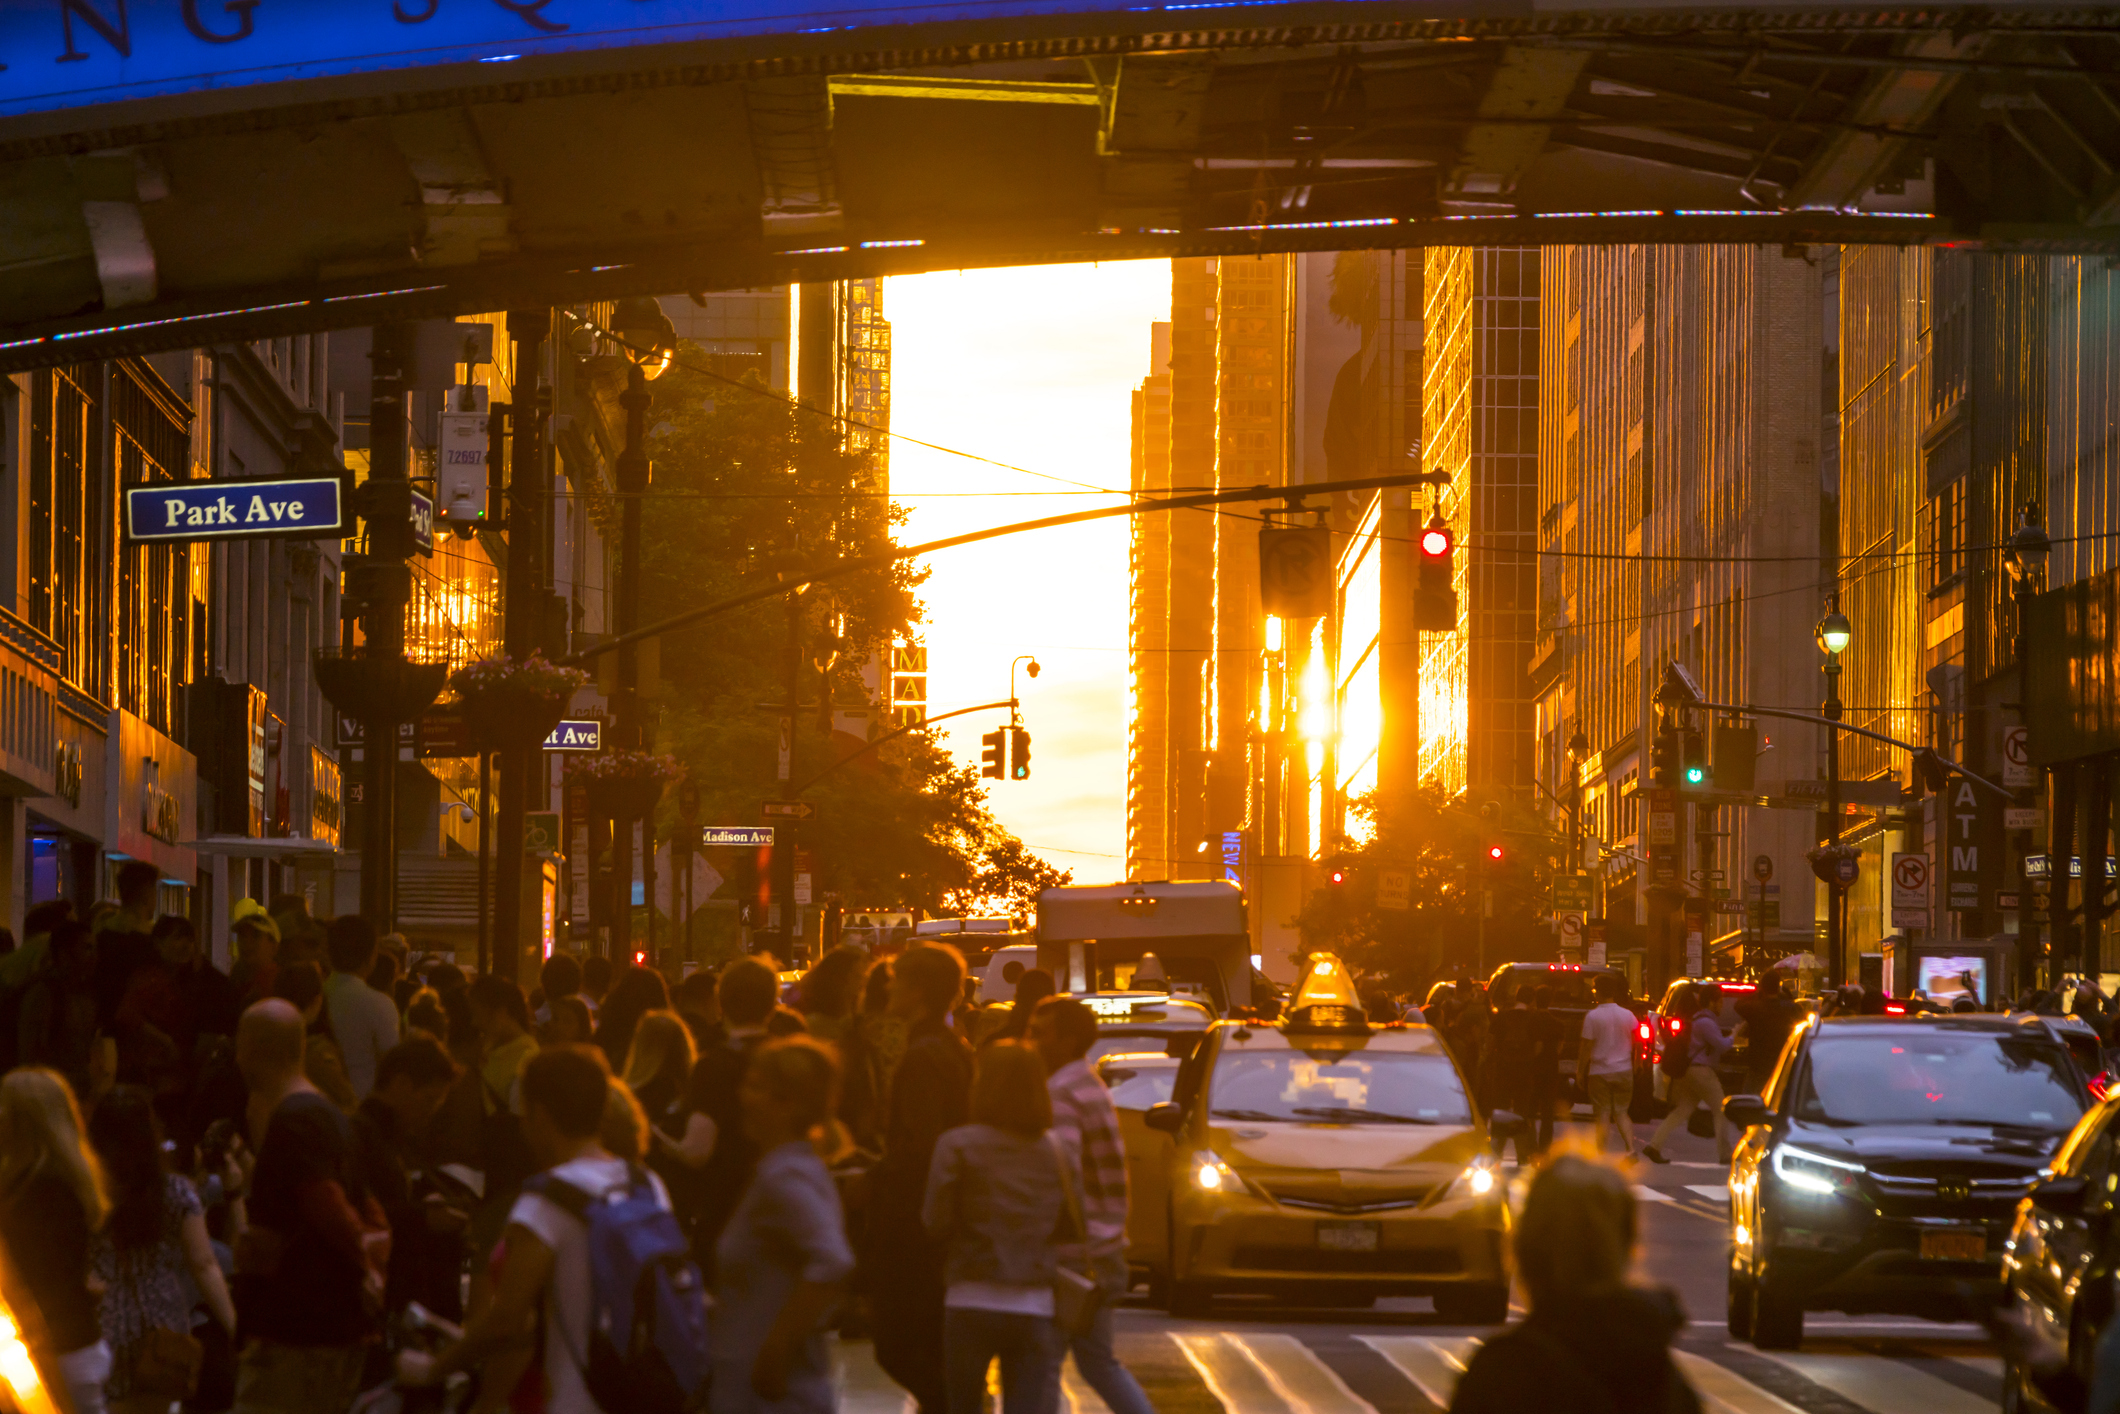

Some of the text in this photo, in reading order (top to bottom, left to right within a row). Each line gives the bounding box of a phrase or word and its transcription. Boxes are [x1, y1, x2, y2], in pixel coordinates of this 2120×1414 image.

[448, 450, 481, 464] 72697
[164, 494, 304, 527] Park Ave
[562, 727, 597, 744] Ave
[1953, 781, 1978, 872] ATM
[703, 831, 772, 844] Madison Ave
[1222, 832, 1241, 866] NEW
[1386, 876, 1403, 888] NO
[1379, 889, 1409, 900] TURNS
[1723, 903, 1744, 912] Fifth
